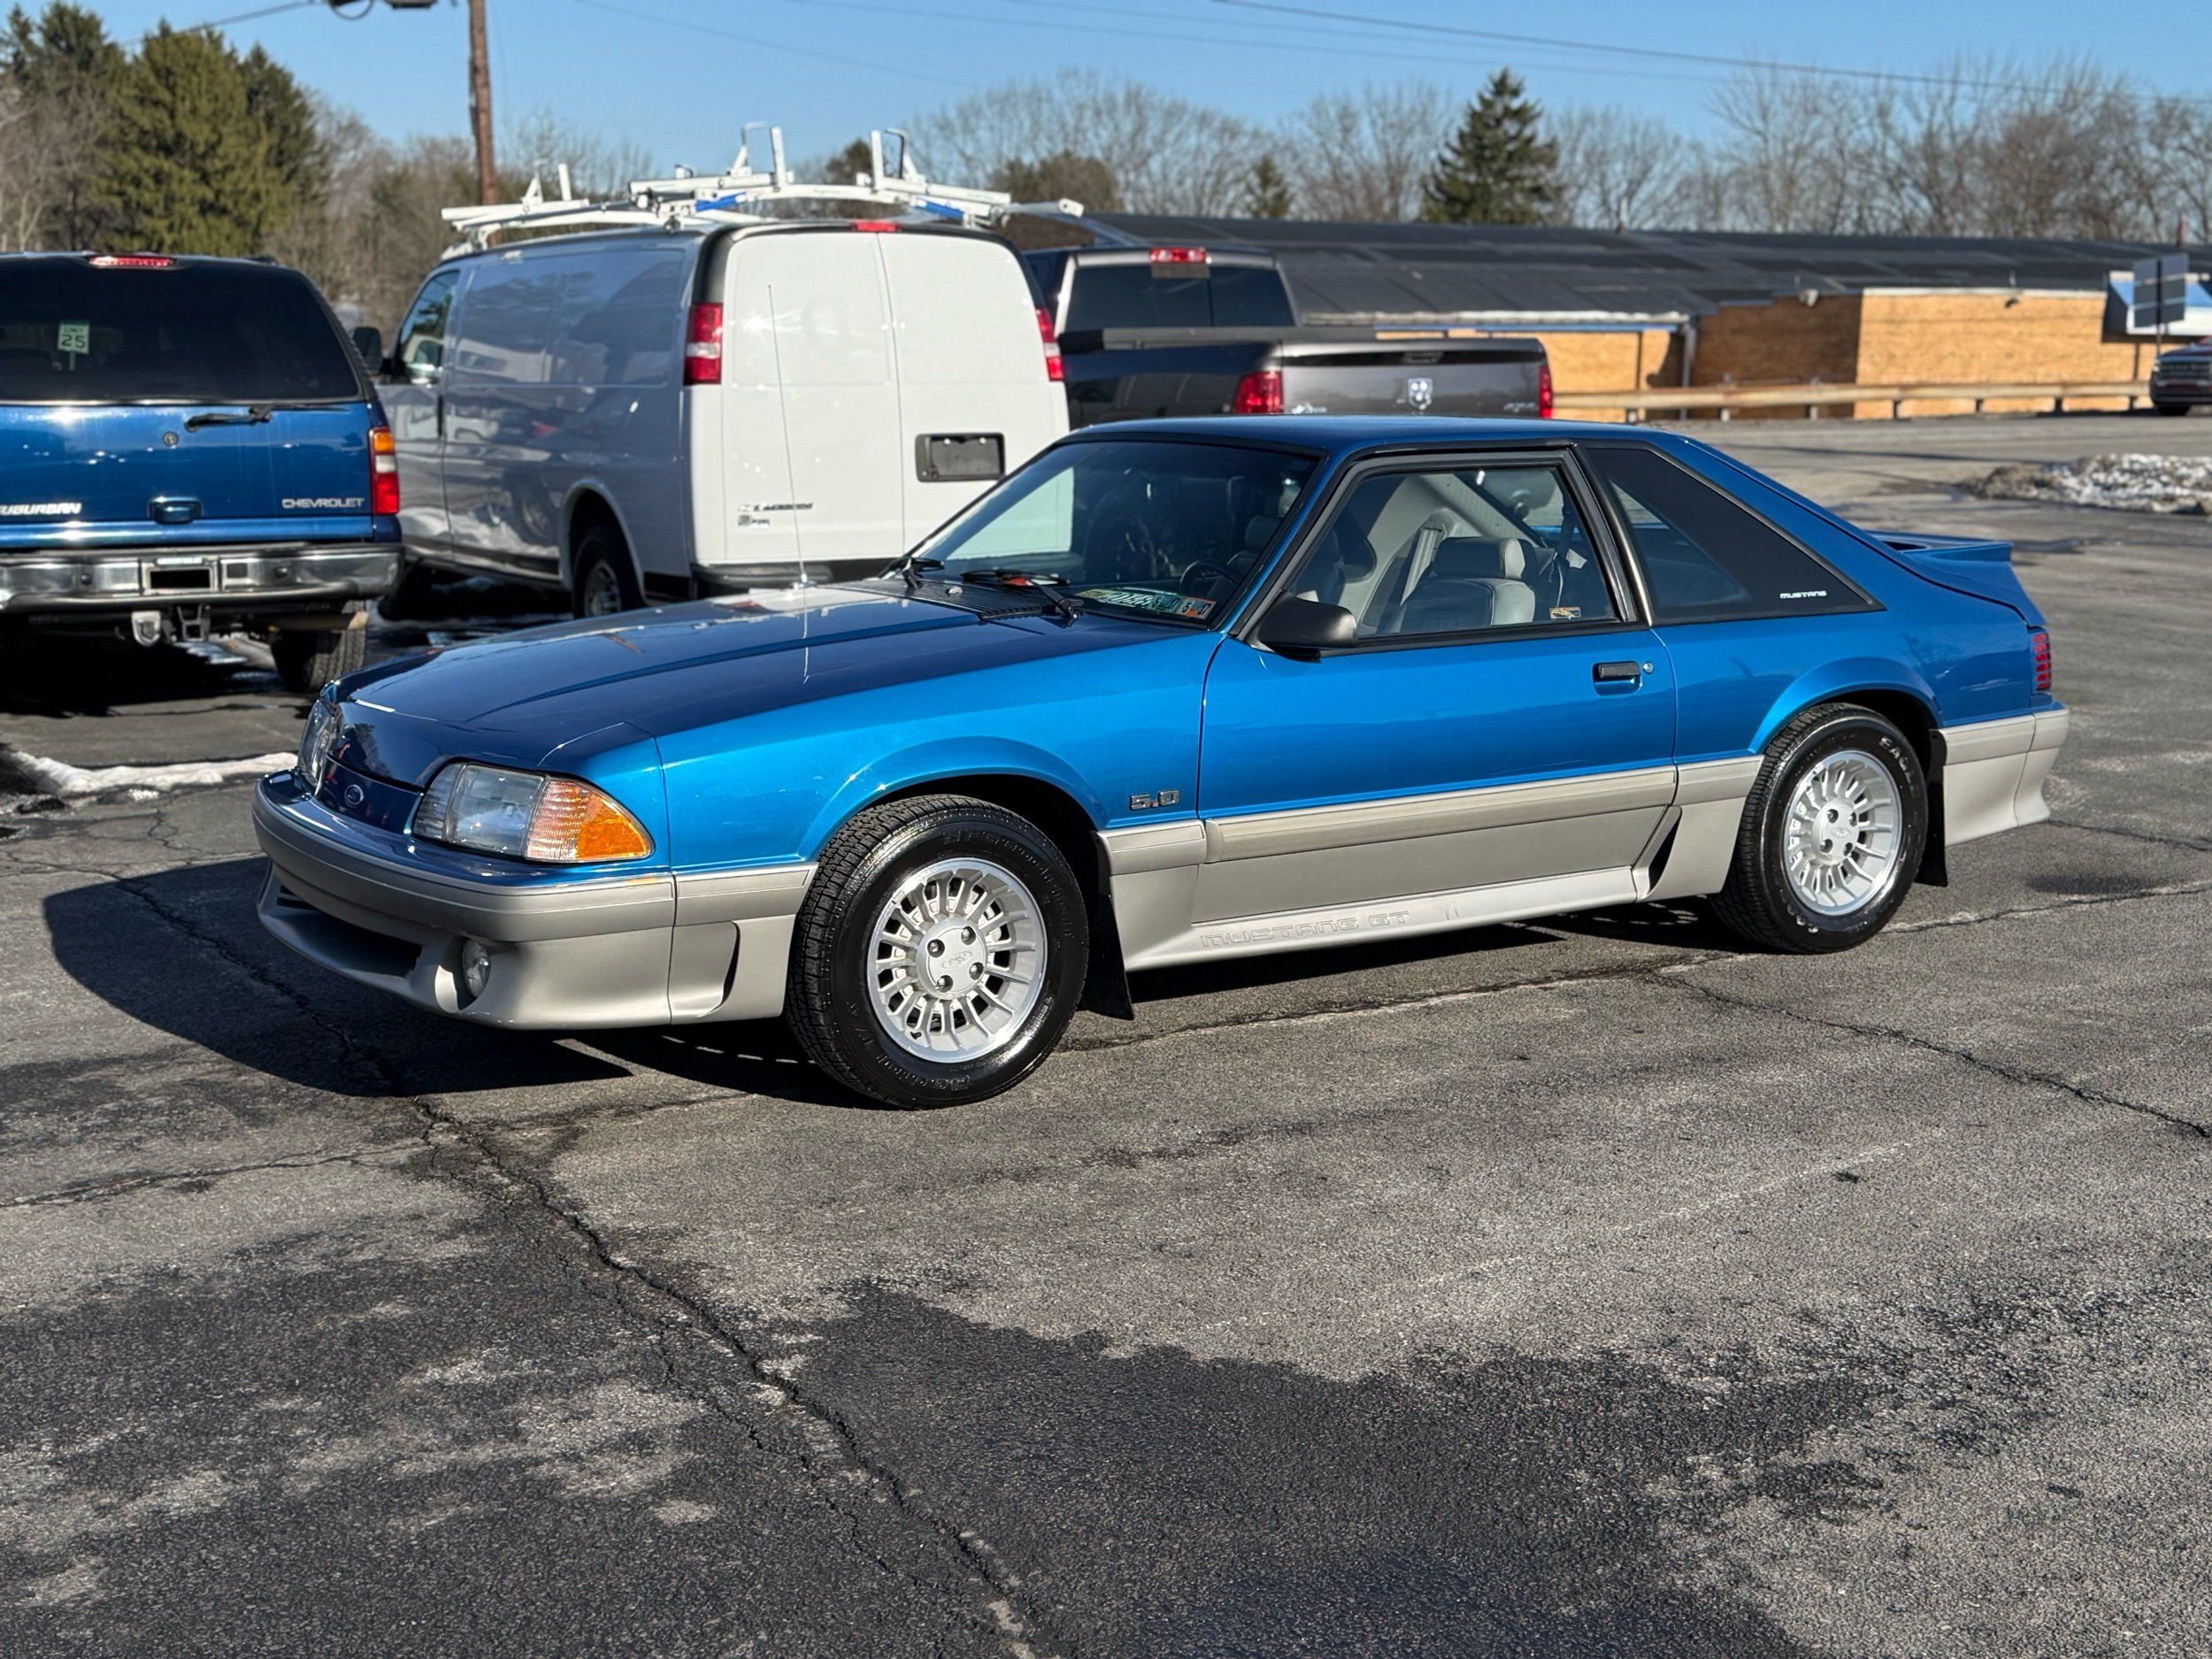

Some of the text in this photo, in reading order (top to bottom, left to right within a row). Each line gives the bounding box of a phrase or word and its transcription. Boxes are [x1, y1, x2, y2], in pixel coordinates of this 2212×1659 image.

[61, 334, 86, 349] 25
[0, 503, 82, 515] UBURBAN
[281, 497, 365, 509] CHEVROLET
[1779, 590, 1827, 599] MUSTANG
[1130, 789, 1179, 810] 5.0
[1199, 910, 1409, 949] MUSTANG GT
